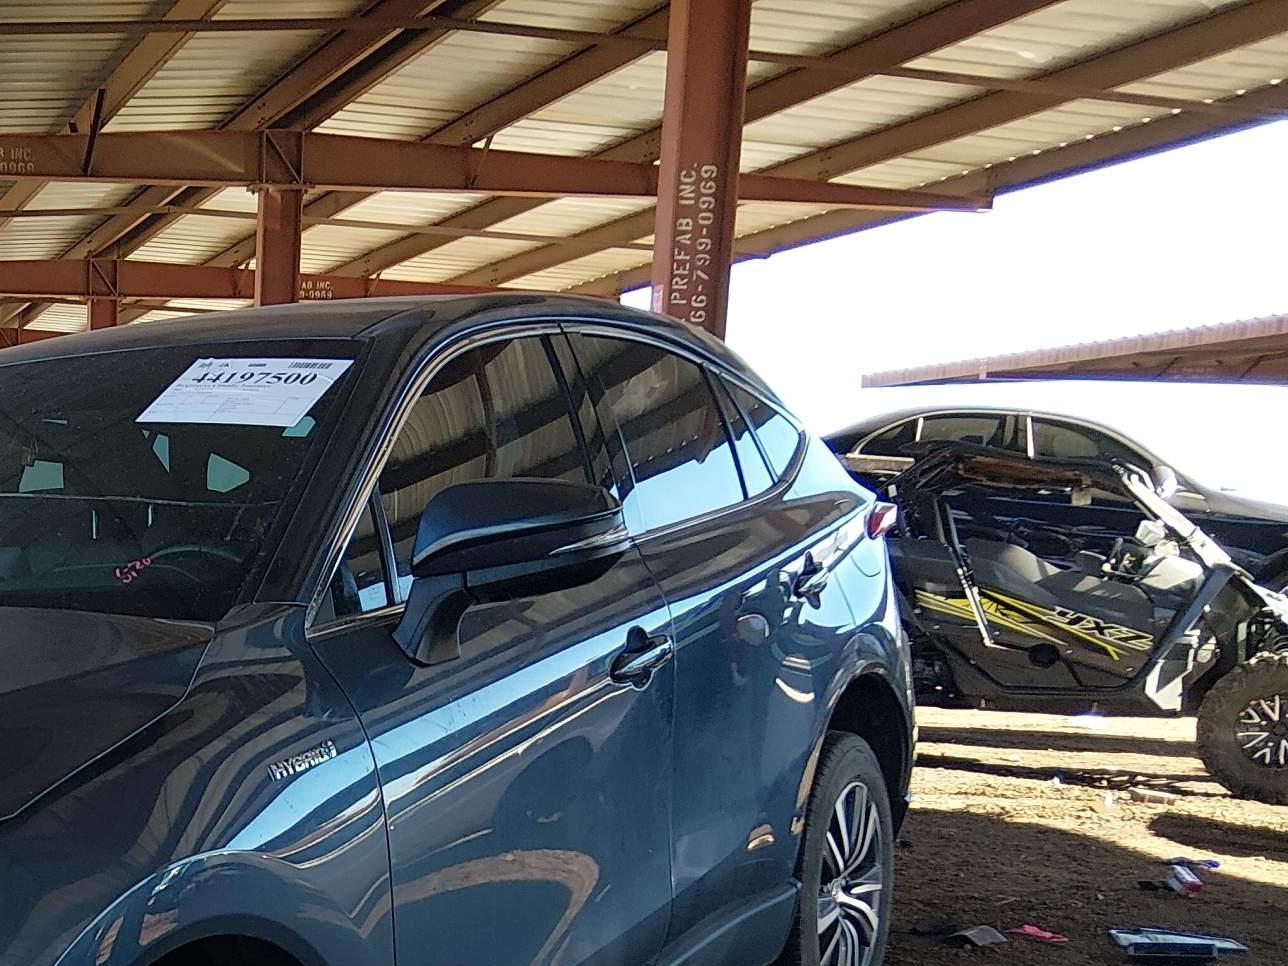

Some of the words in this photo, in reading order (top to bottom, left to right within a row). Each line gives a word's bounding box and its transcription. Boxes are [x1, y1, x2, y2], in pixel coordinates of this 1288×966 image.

[679, 162, 699, 205] INC.
[670, 217, 693, 304] PREFAB
[316, 280, 333, 291] INC.
[191, 371, 318, 386] 44197500
[1043, 605, 1155, 651] YXZ
[268, 744, 332, 780] HYBRID
